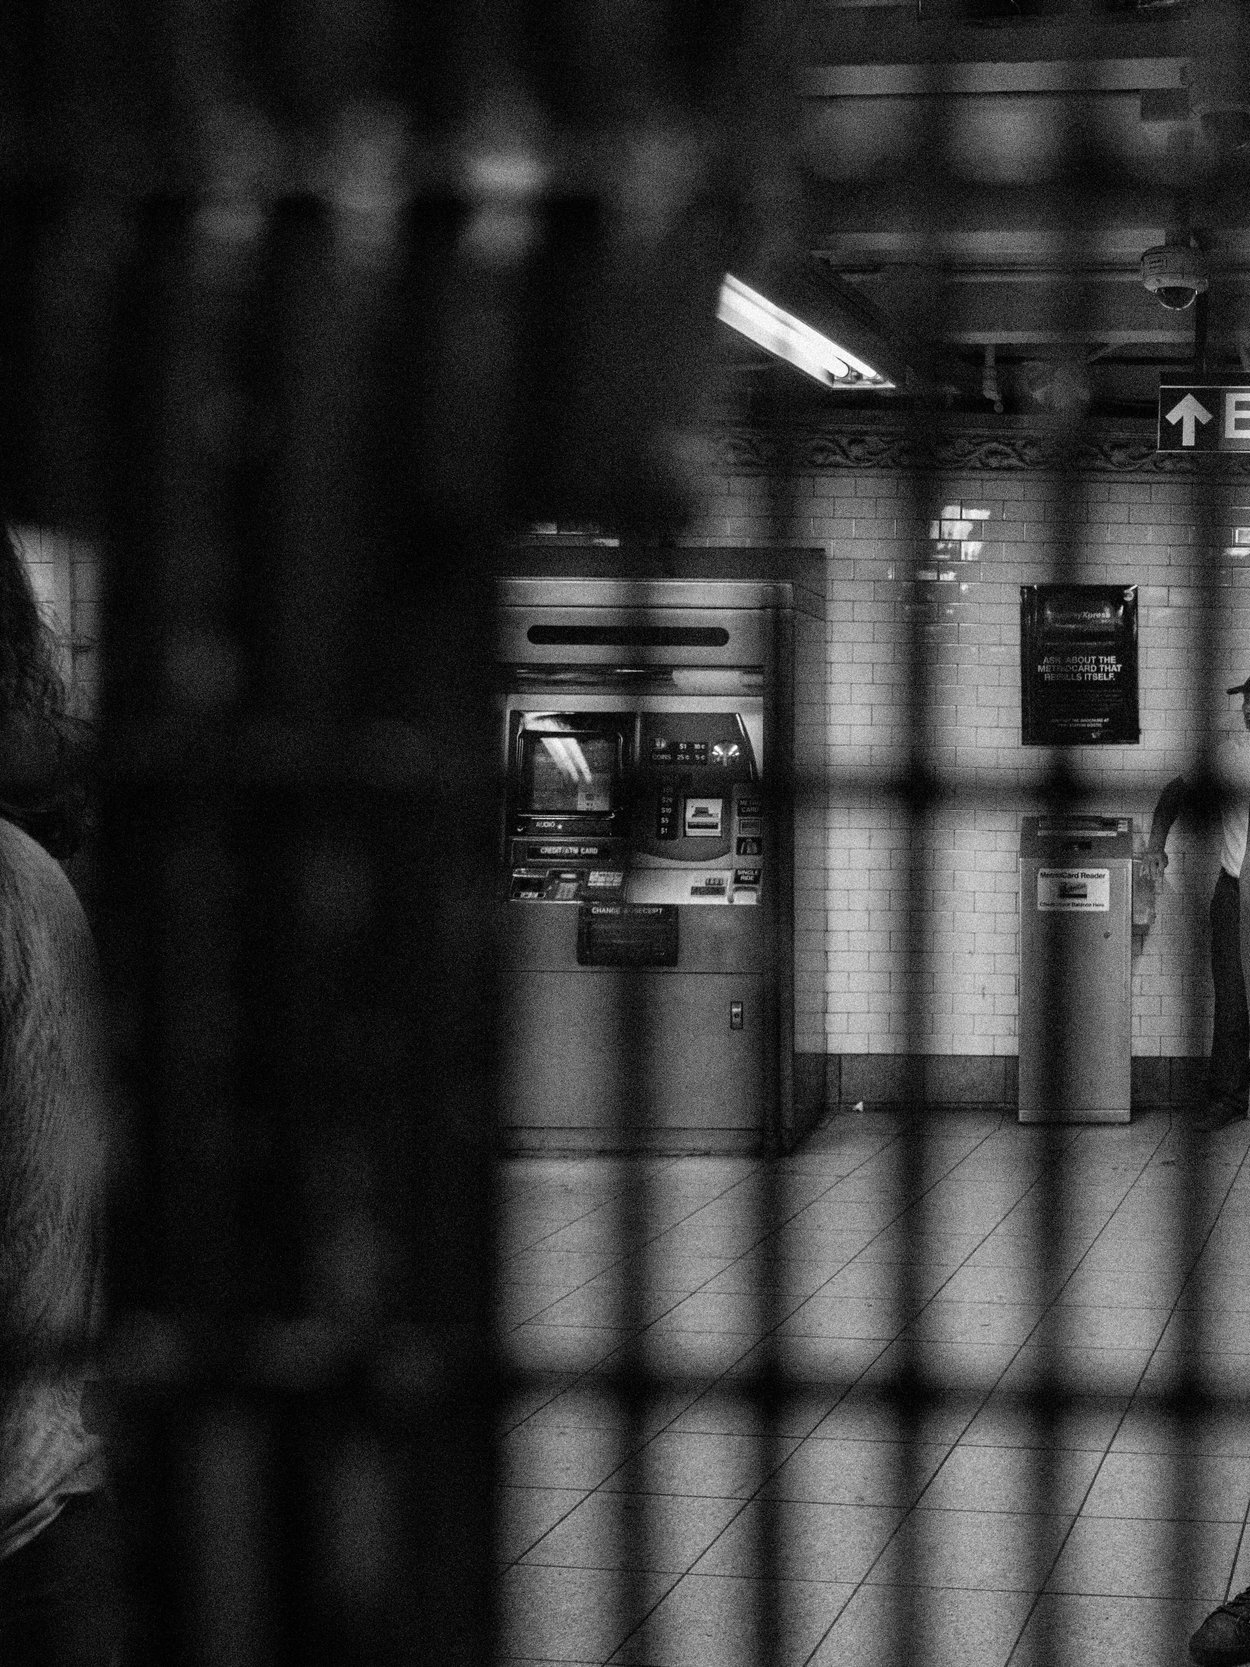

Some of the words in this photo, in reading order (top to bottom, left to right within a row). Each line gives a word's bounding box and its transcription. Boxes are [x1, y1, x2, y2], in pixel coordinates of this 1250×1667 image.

[1066, 655, 1096, 664] ABOUT
[1098, 655, 1116, 664] THE
[1099, 664, 1122, 673] THAT
[1084, 672, 1116, 681] ITSELF.
